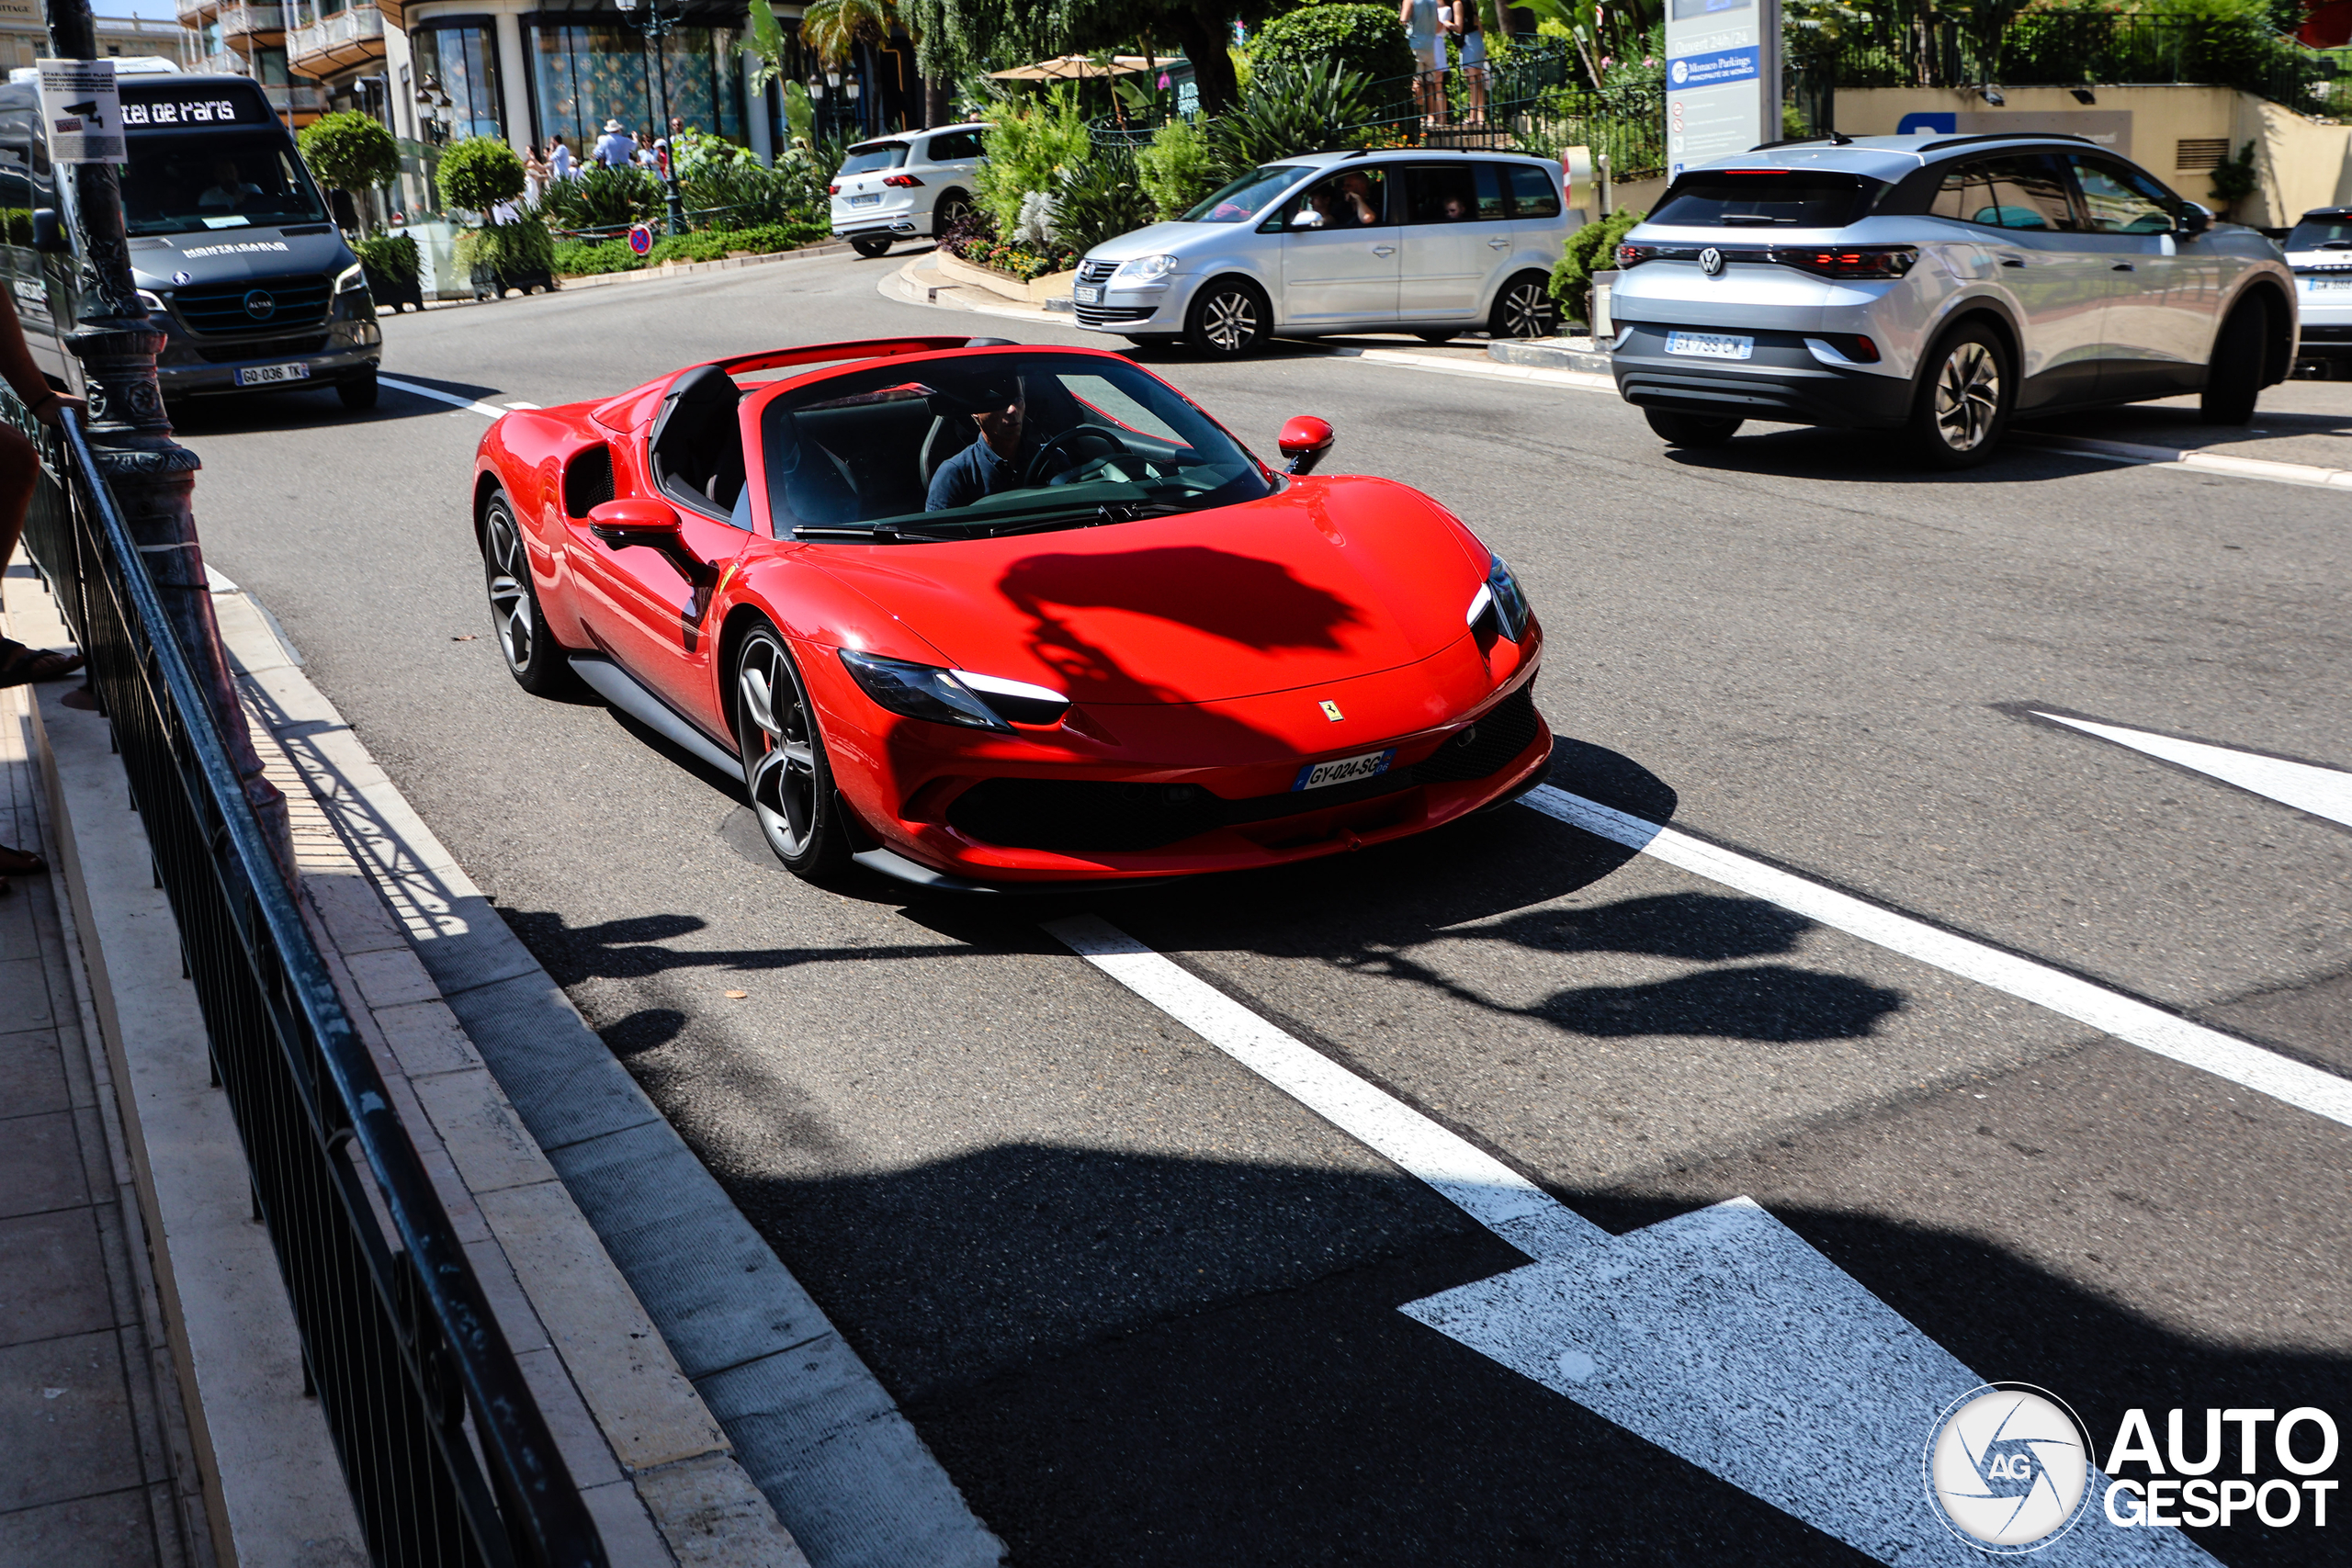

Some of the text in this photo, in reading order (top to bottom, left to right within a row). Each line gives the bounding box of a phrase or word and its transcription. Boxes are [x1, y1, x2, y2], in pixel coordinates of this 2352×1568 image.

[1675, 30, 1749, 54] Ouvert 24h/24
[1689, 61, 1718, 73] Monaco
[1718, 56, 1751, 69] Parkings
[152, 103, 179, 122] de
[1309, 756, 1389, 784] GY-024-SG 06
